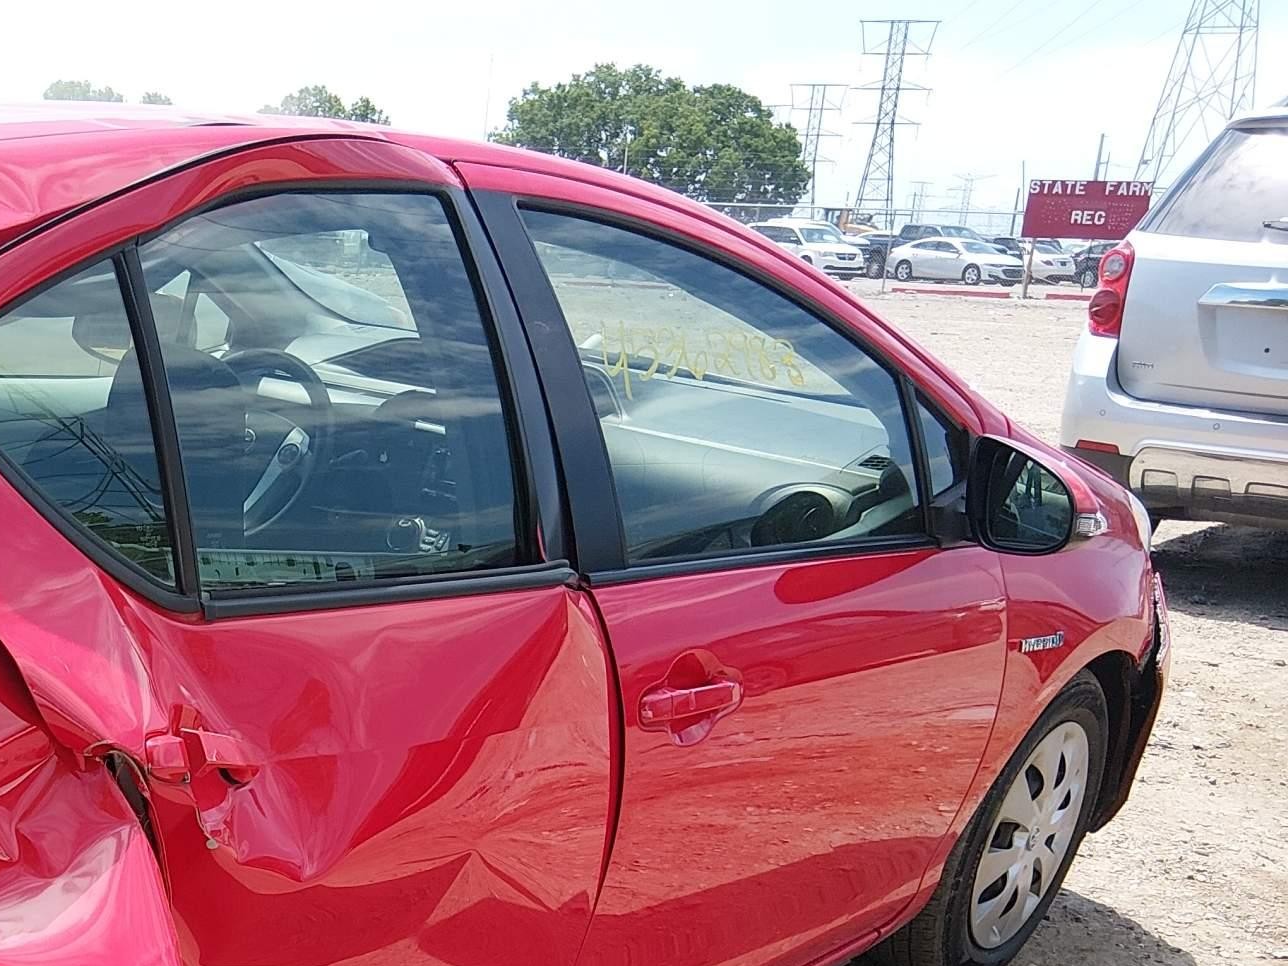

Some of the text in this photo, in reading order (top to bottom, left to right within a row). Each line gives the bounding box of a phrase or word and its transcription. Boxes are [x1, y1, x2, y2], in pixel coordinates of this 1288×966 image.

[1030, 180, 1153, 196] STATE FARM
[1070, 210, 1106, 225] REG
